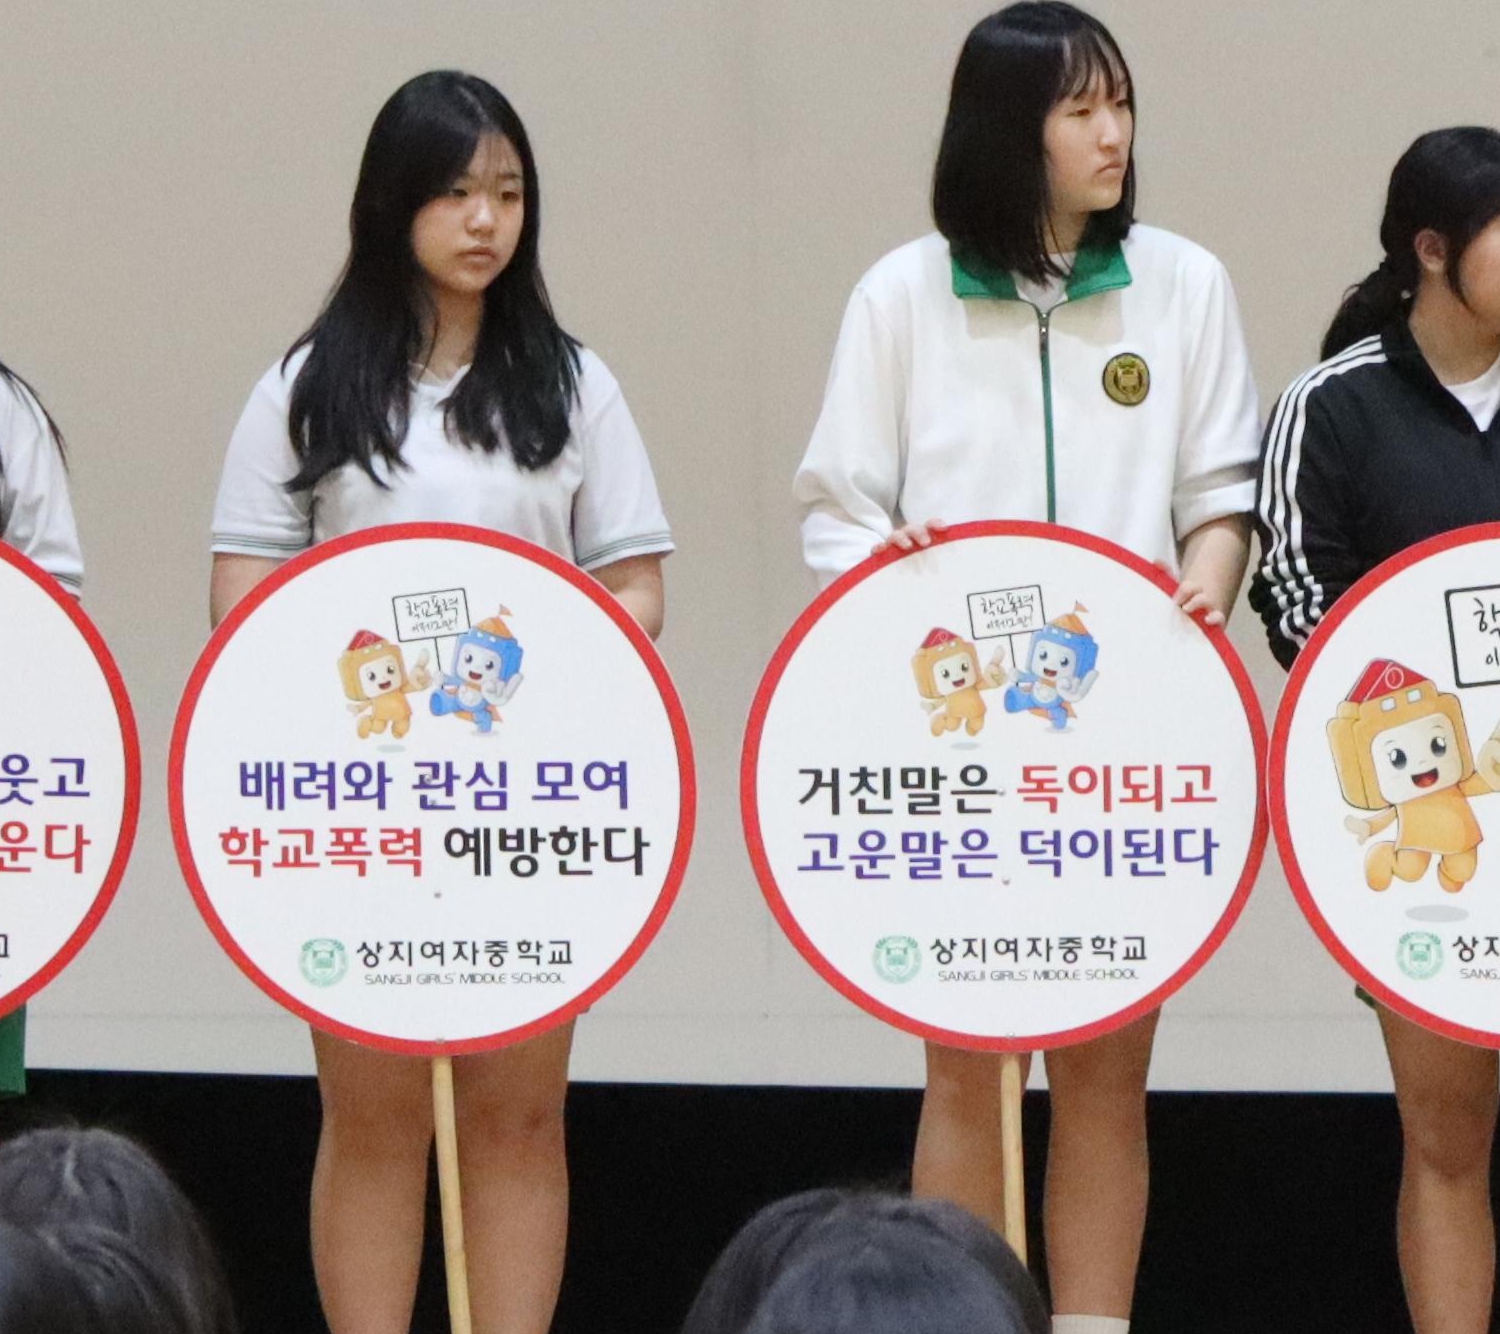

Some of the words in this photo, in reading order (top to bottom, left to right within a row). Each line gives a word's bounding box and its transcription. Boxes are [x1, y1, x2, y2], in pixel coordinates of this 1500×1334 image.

[240, 761, 393, 811] 배려와
[412, 761, 508, 811] 관심
[532, 760, 629, 811] 모여
[798, 764, 997, 815] 거친말은
[1017, 764, 1217, 813] 독이되고
[219, 826, 423, 877] 학교폭력
[444, 825, 650, 877] 예방한다
[798, 829, 999, 879] 고운말은
[1020, 828, 1220, 877] 덕이된다
[356, 940, 572, 967] 상지여자중학교
[930, 935, 1147, 964] 상지여자중학교
[365, 973, 411, 984] SANGJI
[460, 973, 506, 984] MIDDLE
[511, 972, 565, 983] SCHOOL
[938, 970, 985, 981] SANGJI
[1034, 970, 1080, 980] MIDDLE
[1085, 969, 1139, 980] SCHOOL
